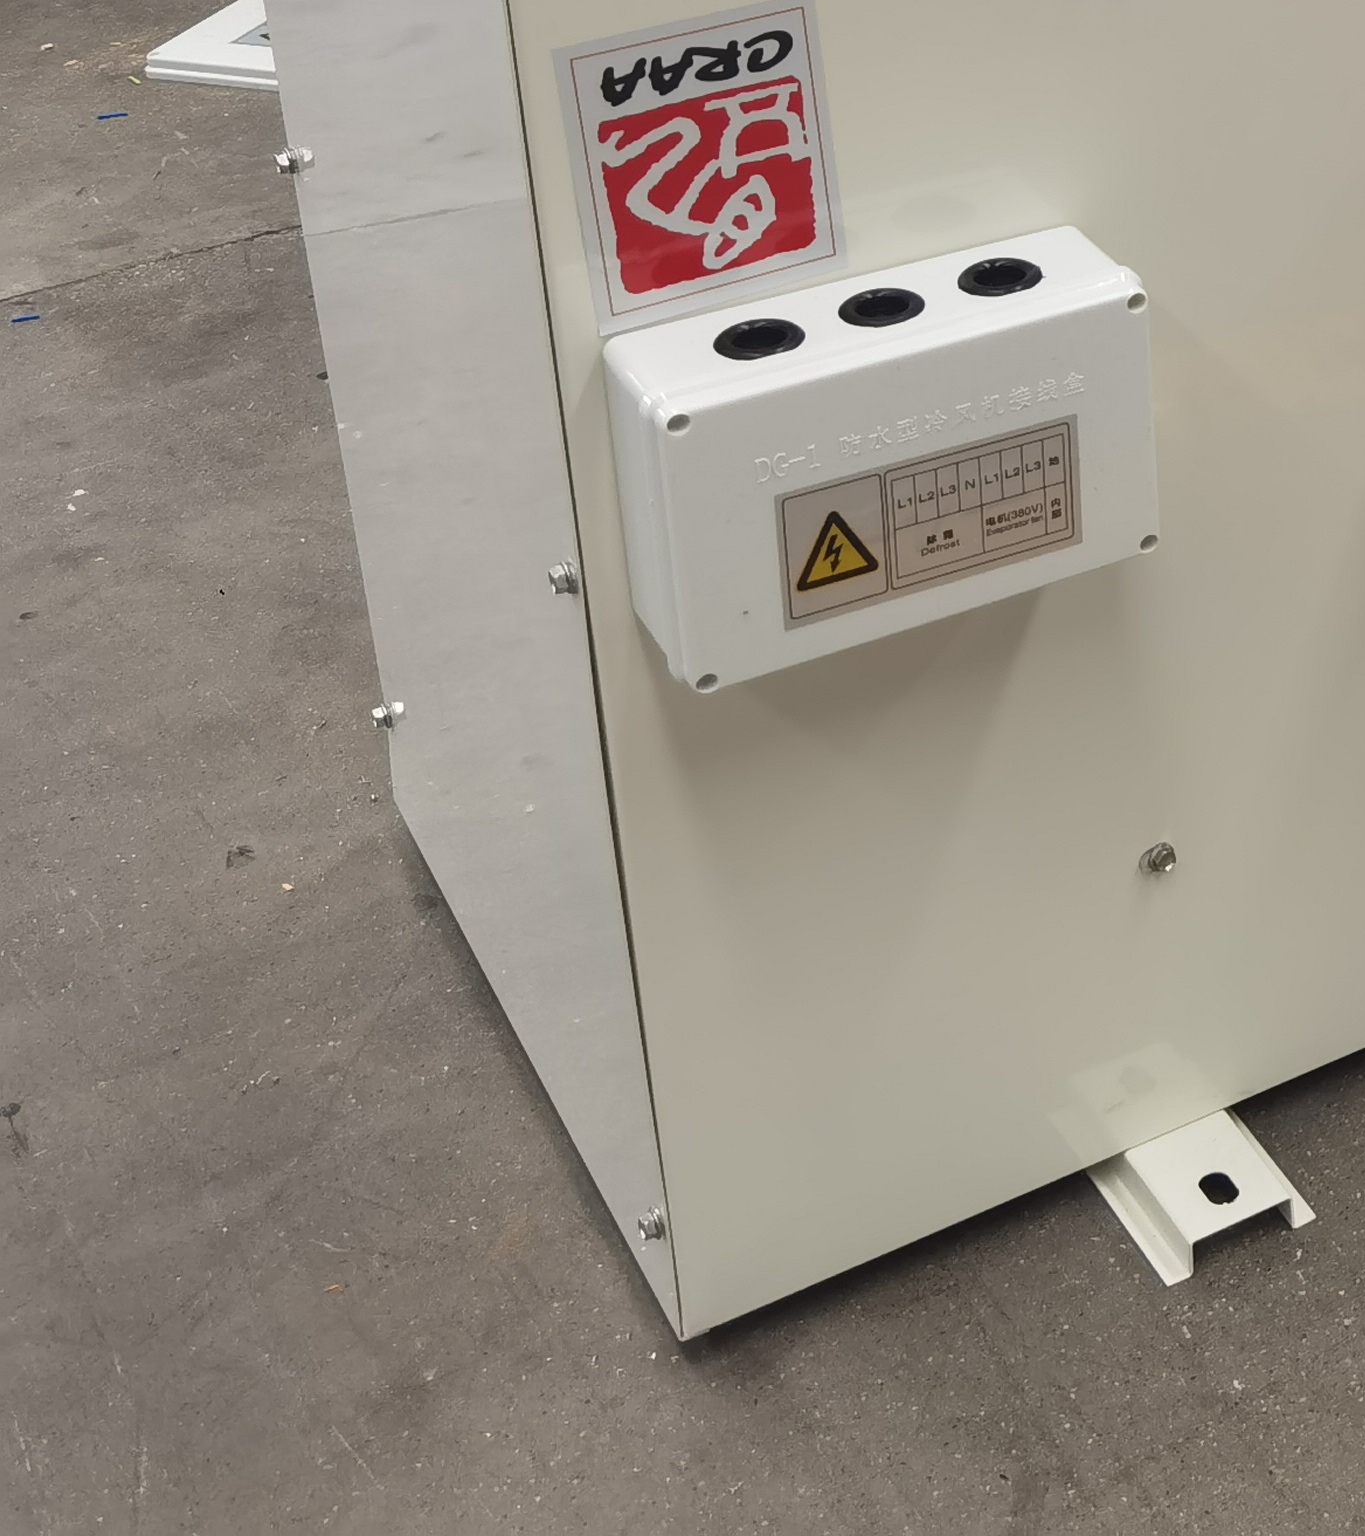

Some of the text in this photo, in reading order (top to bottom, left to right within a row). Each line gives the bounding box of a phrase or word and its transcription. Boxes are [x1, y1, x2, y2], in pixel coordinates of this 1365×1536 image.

[600, 30, 793, 107] CRAA
[898, 497, 913, 509] L1
[918, 490, 935, 503] L2
[940, 484, 957, 497] L3
[964, 478, 976, 491] N
[984, 472, 1000, 485] L1
[1004, 466, 1020, 479] L2
[1025, 461, 1042, 474] L3
[920, 539, 961, 557] Defrost
